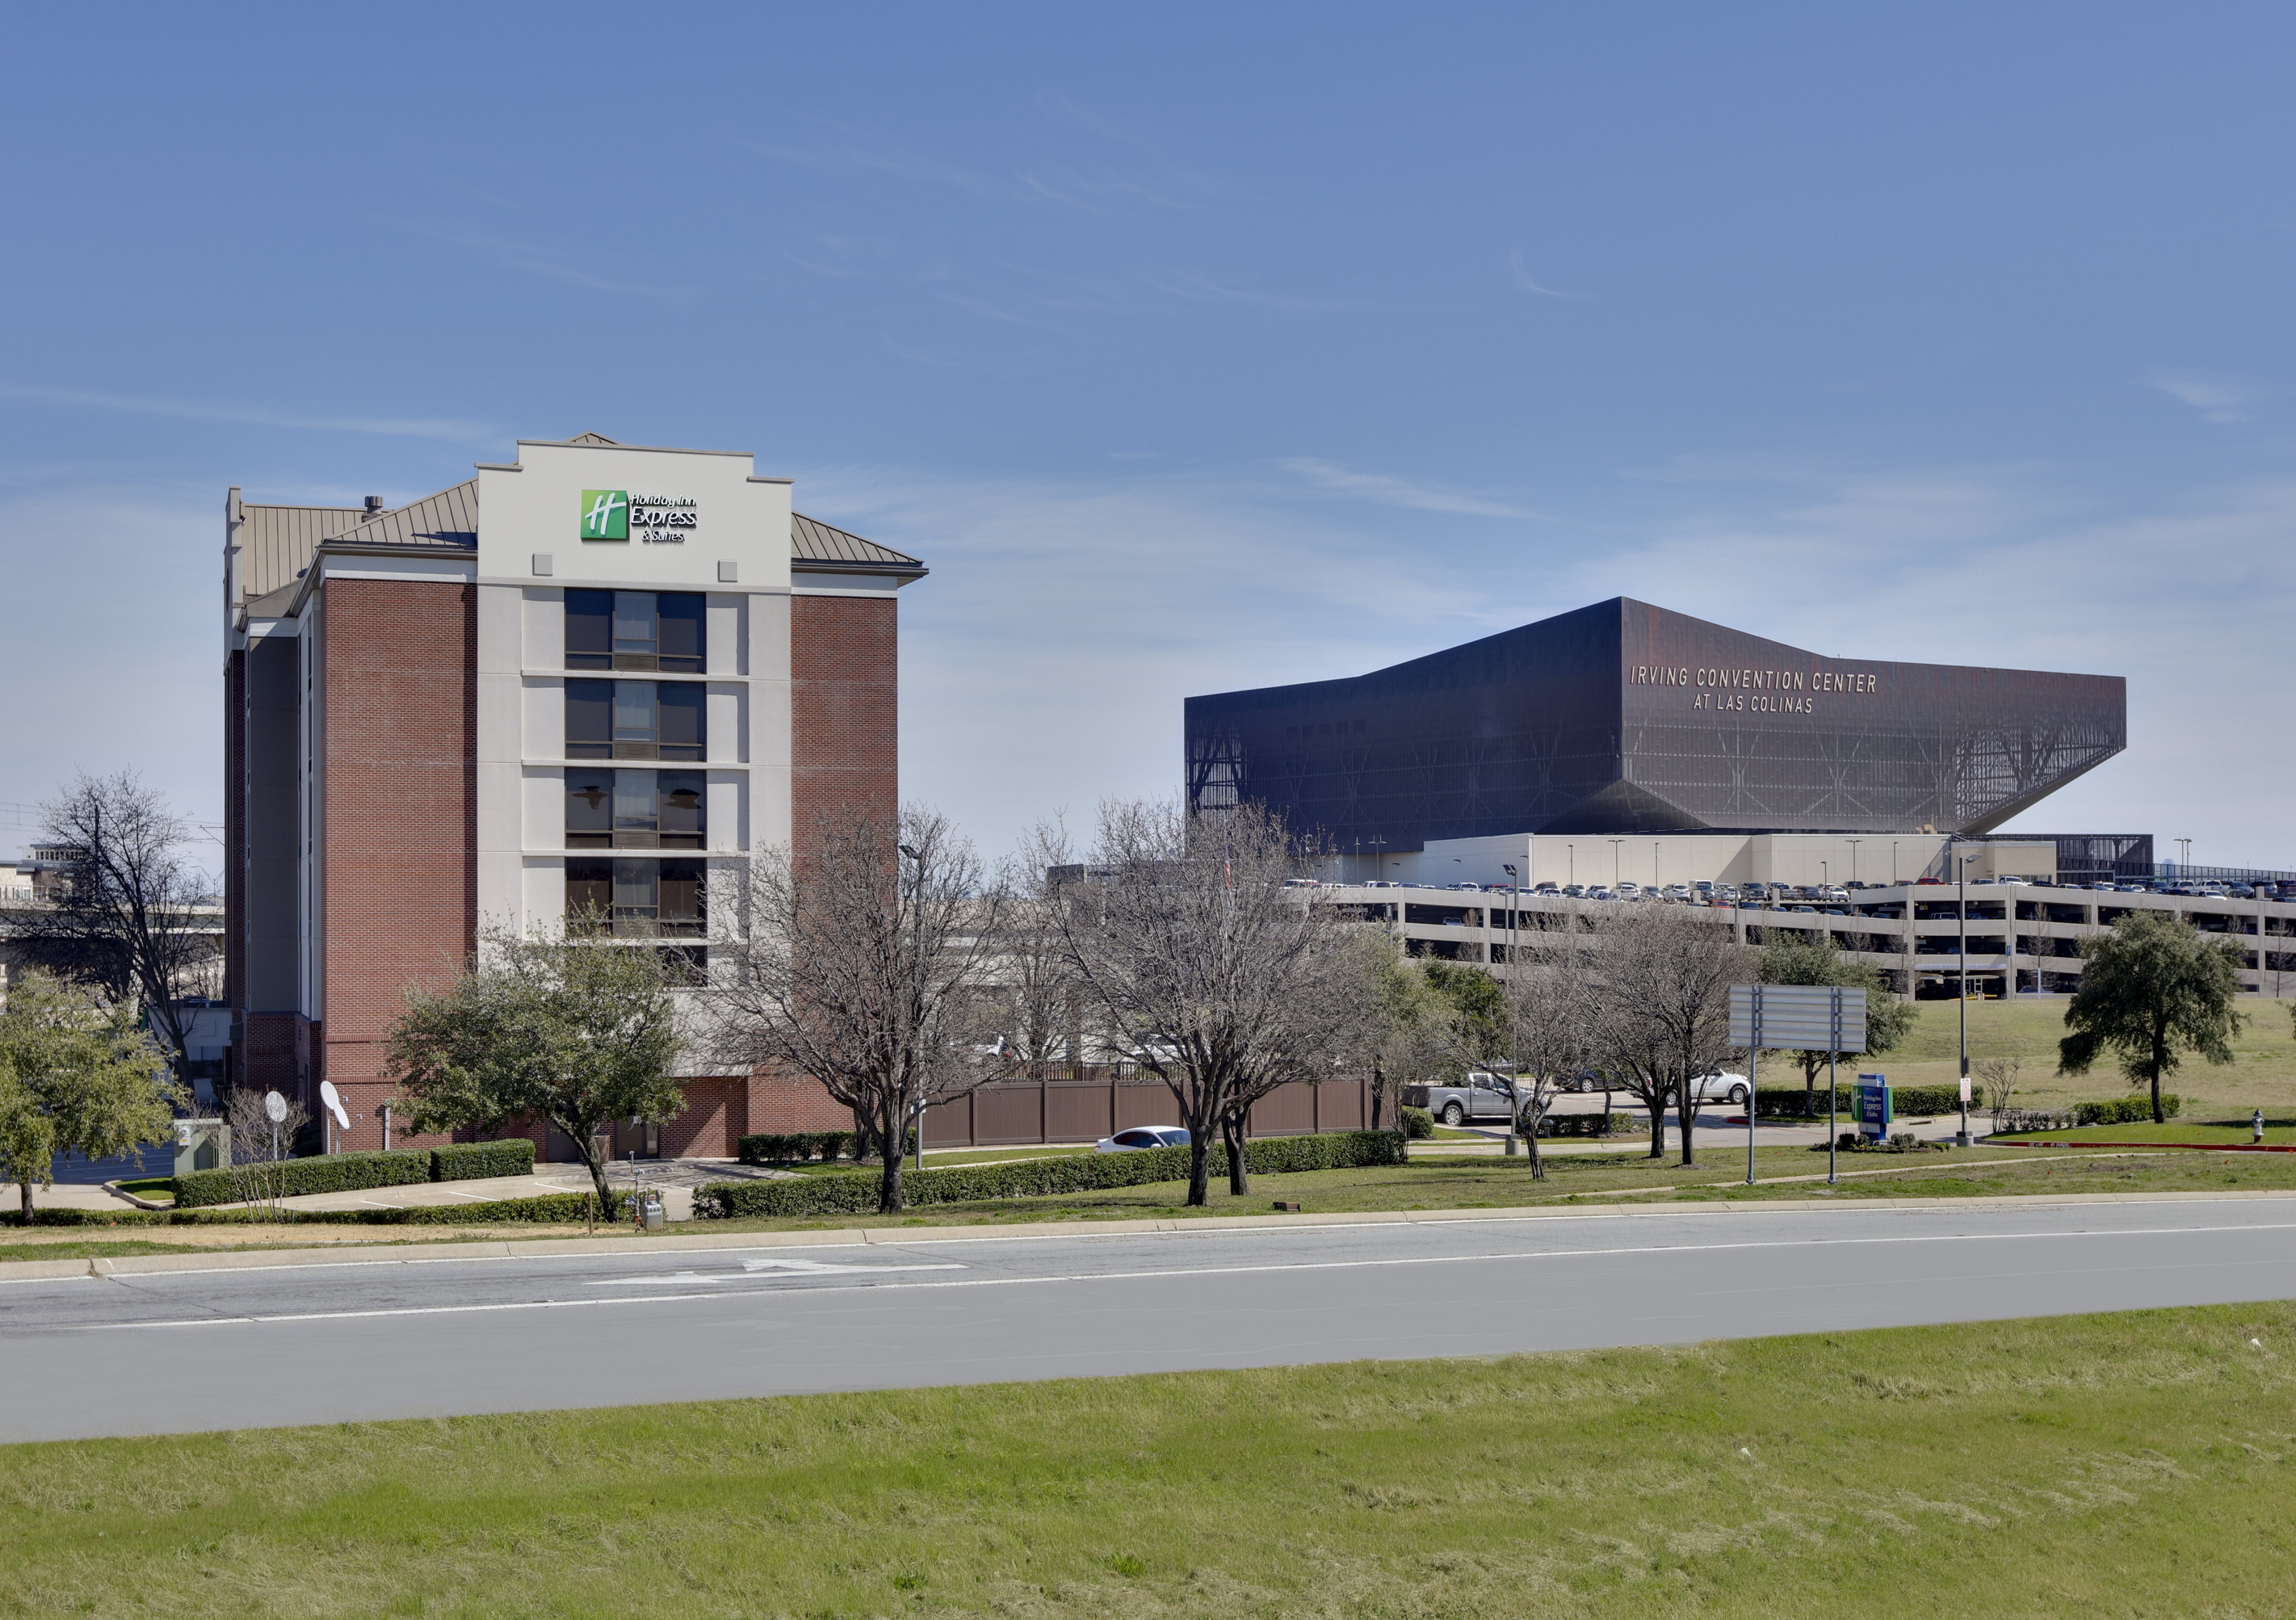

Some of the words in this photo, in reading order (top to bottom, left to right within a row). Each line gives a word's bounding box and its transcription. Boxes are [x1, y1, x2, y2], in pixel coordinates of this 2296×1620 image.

[630, 492, 676, 508] Holiday
[678, 493, 697, 506] Inn
[585, 492, 626, 535] H
[631, 506, 697, 528] Express
[642, 530, 650, 541] &
[651, 530, 684, 541] Suites
[1630, 665, 1688, 687] IRVING
[1696, 668, 1804, 691] CONVENTION
[1812, 672, 1876, 694] CENTER
[1693, 693, 1710, 711] AT
[1717, 694, 1744, 712] LAS
[1751, 696, 1813, 714] COLINAS
[1864, 1101, 1882, 1111] Express
